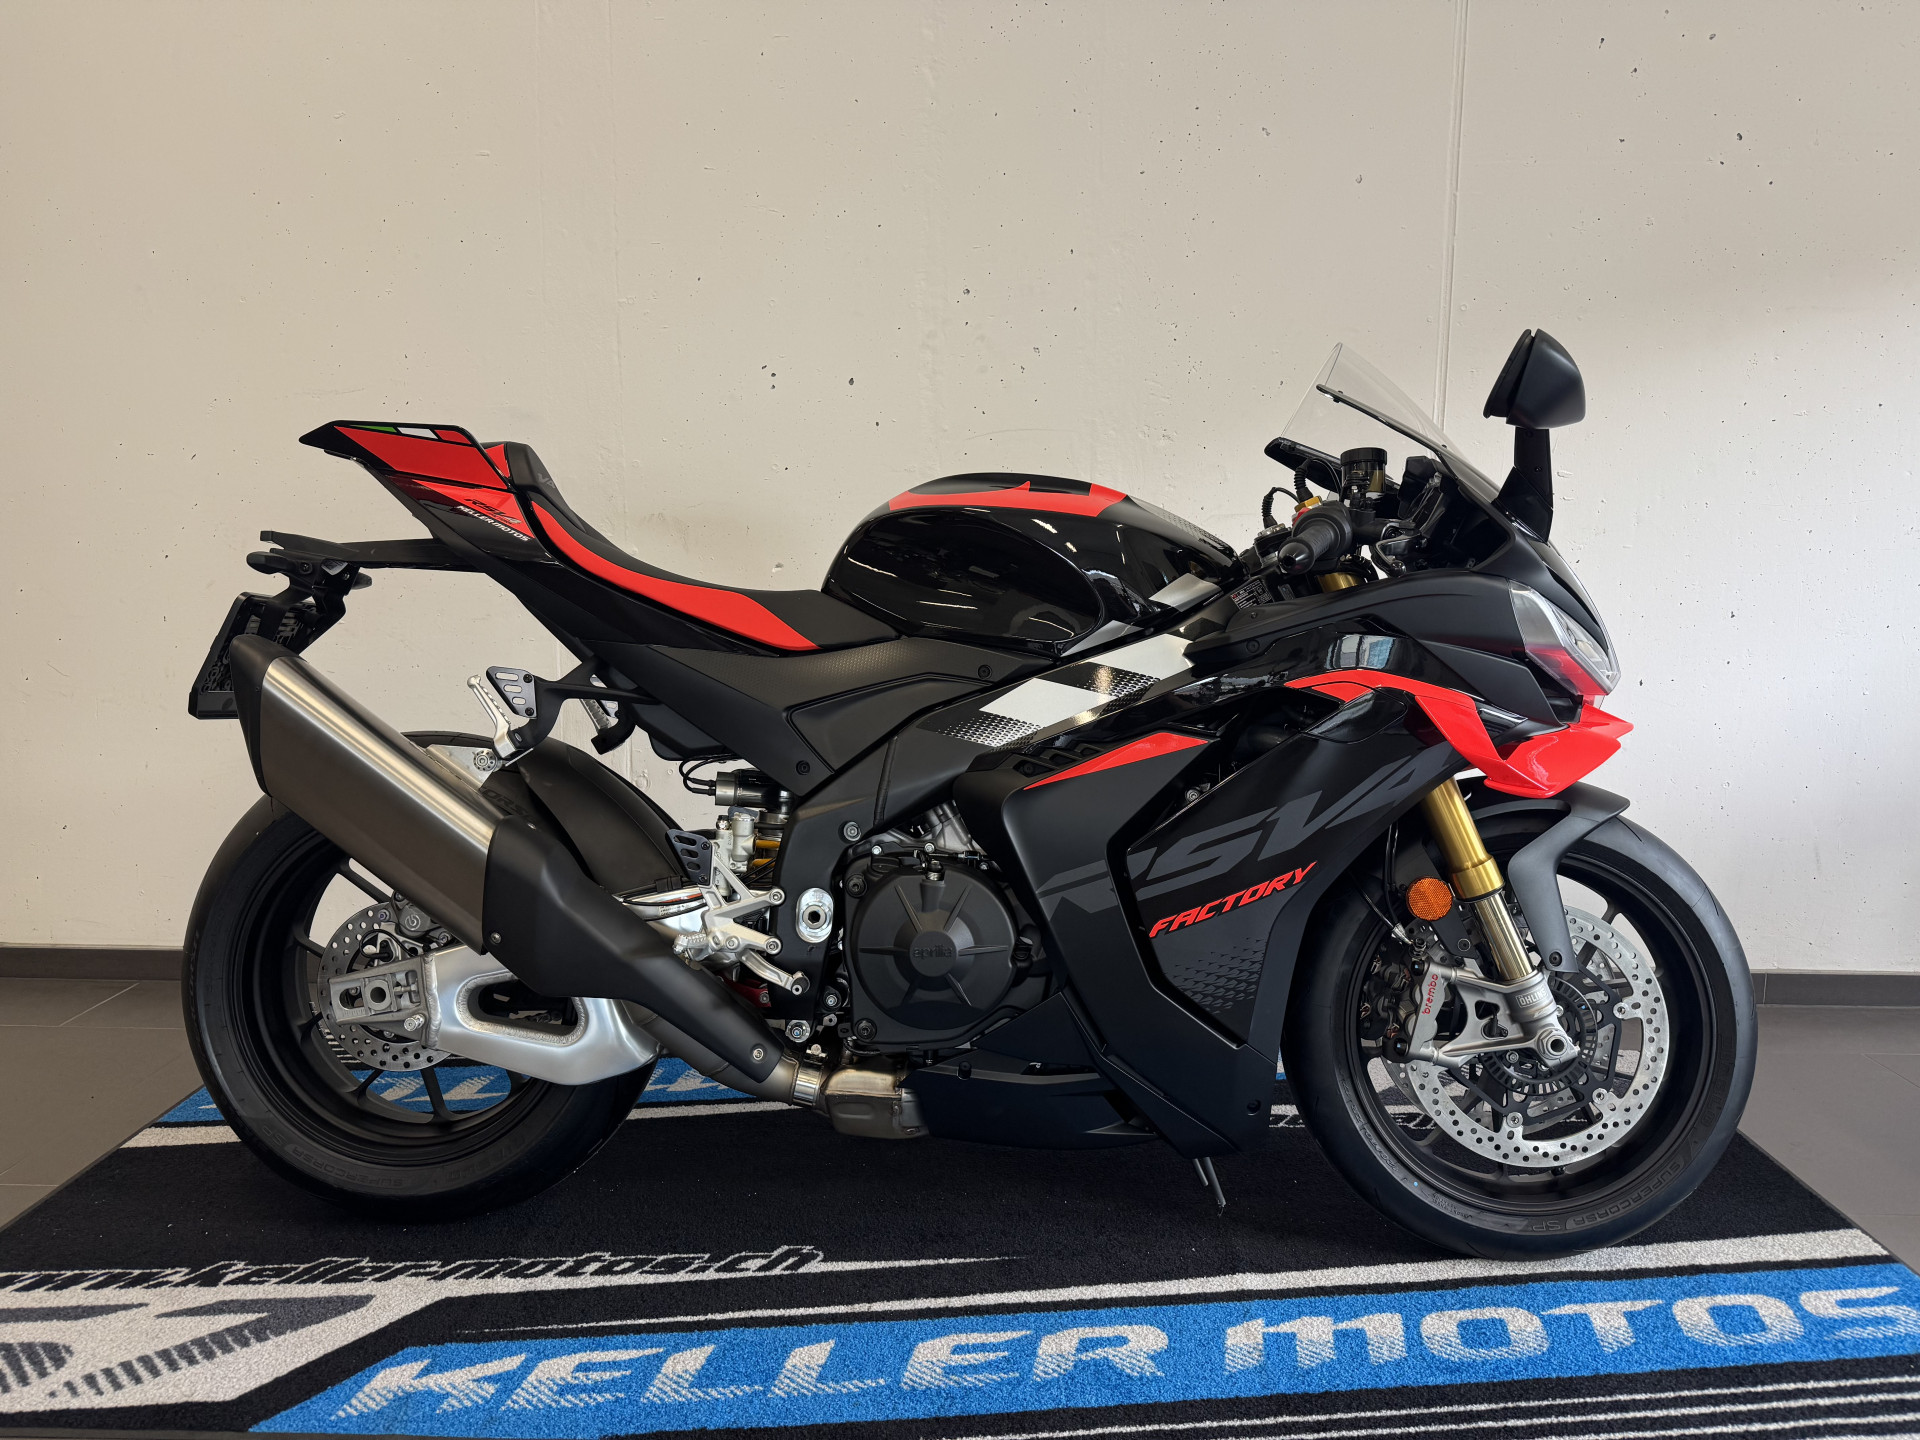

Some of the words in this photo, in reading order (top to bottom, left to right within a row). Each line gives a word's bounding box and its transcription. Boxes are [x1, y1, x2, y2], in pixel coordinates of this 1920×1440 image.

[1148, 861, 1317, 939] FACTORY
[1421, 973, 1439, 1015] brembo
[1532, 1220, 1561, 1232] SP
[1572, 1161, 1682, 1227] SUPERCORSA
[329, 1324, 1169, 1420] KELLER
[1224, 1286, 1920, 1375] MOTOS
